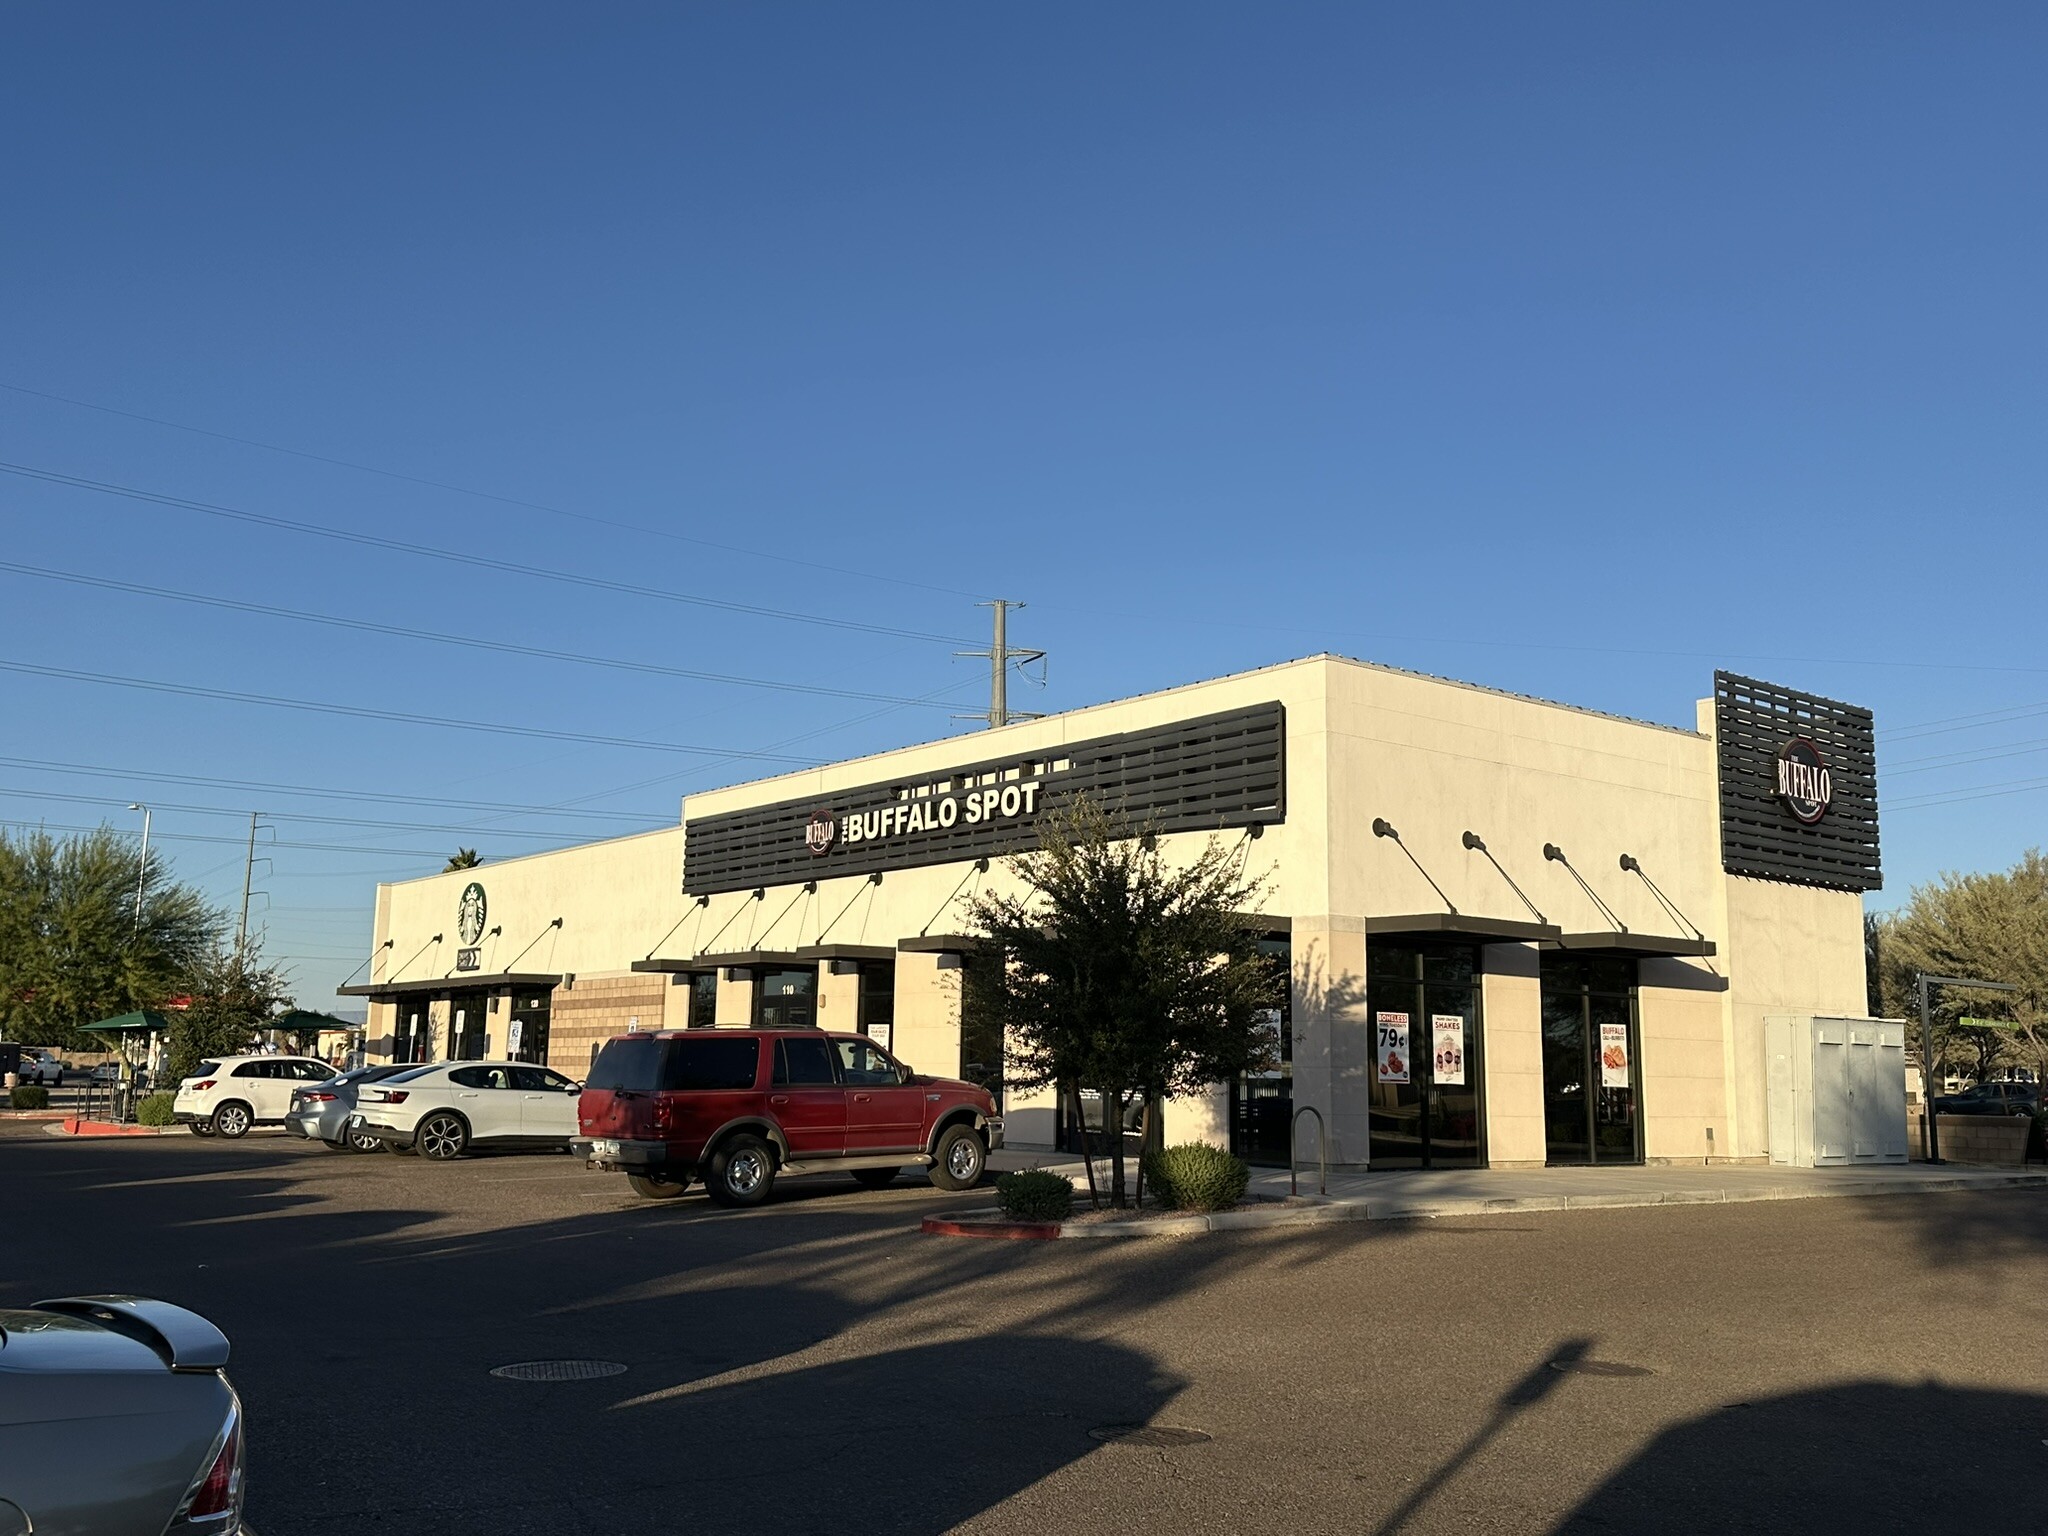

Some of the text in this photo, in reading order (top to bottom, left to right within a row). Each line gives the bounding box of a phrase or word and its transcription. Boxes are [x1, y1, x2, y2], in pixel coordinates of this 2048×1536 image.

[1778, 759, 1831, 804] BUFFALO
[841, 781, 1040, 845] THE BUFFALO SPOT
[805, 821, 834, 844] BUFFALO
[782, 985, 794, 995] 110
[1379, 1014, 1407, 1023] BONELESS
[1435, 1021, 1460, 1030] SHAKES
[1602, 1026, 1625, 1035] BUFFALO
